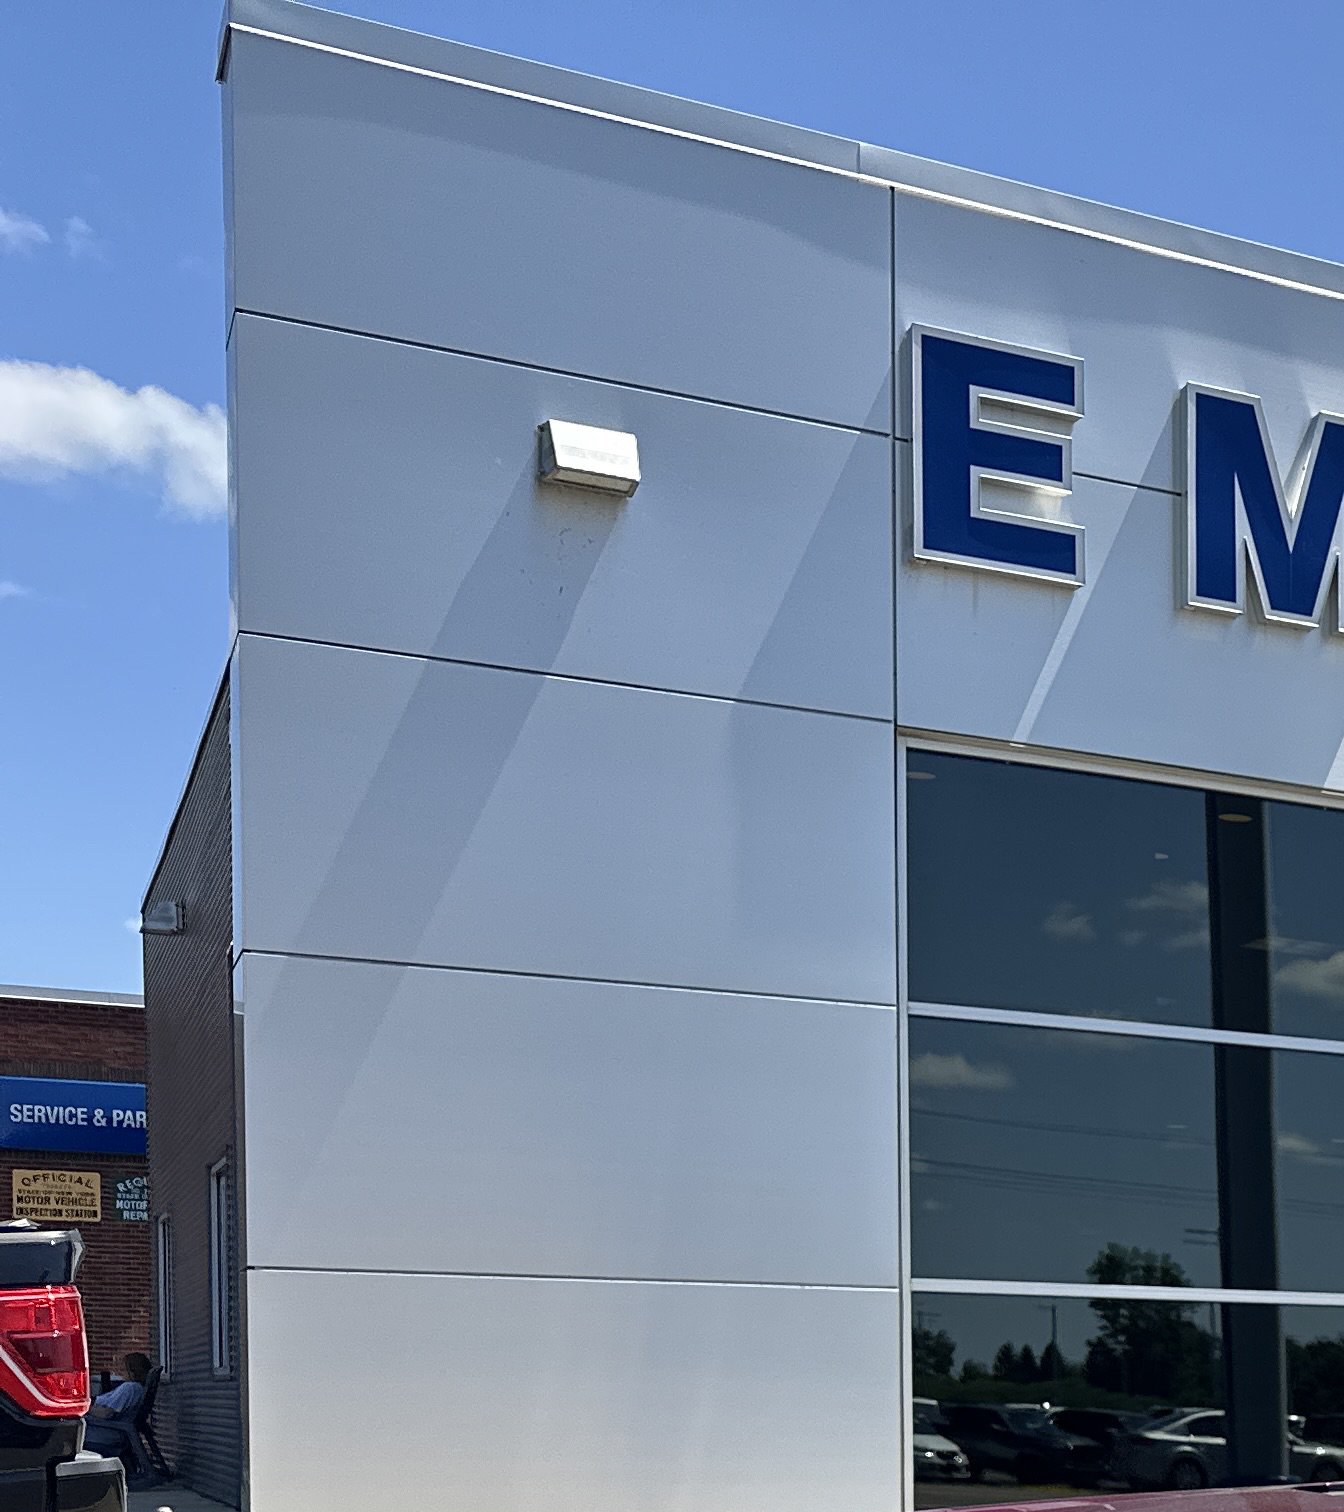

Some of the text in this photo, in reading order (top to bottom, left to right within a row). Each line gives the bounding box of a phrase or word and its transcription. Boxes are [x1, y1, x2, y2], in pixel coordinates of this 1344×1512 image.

[9, 1103, 147, 1129] SERVICE & PAR
[21, 1172, 94, 1190] OFFICIAL
[16, 1194, 97, 1207] MOTOR VEHICLE
